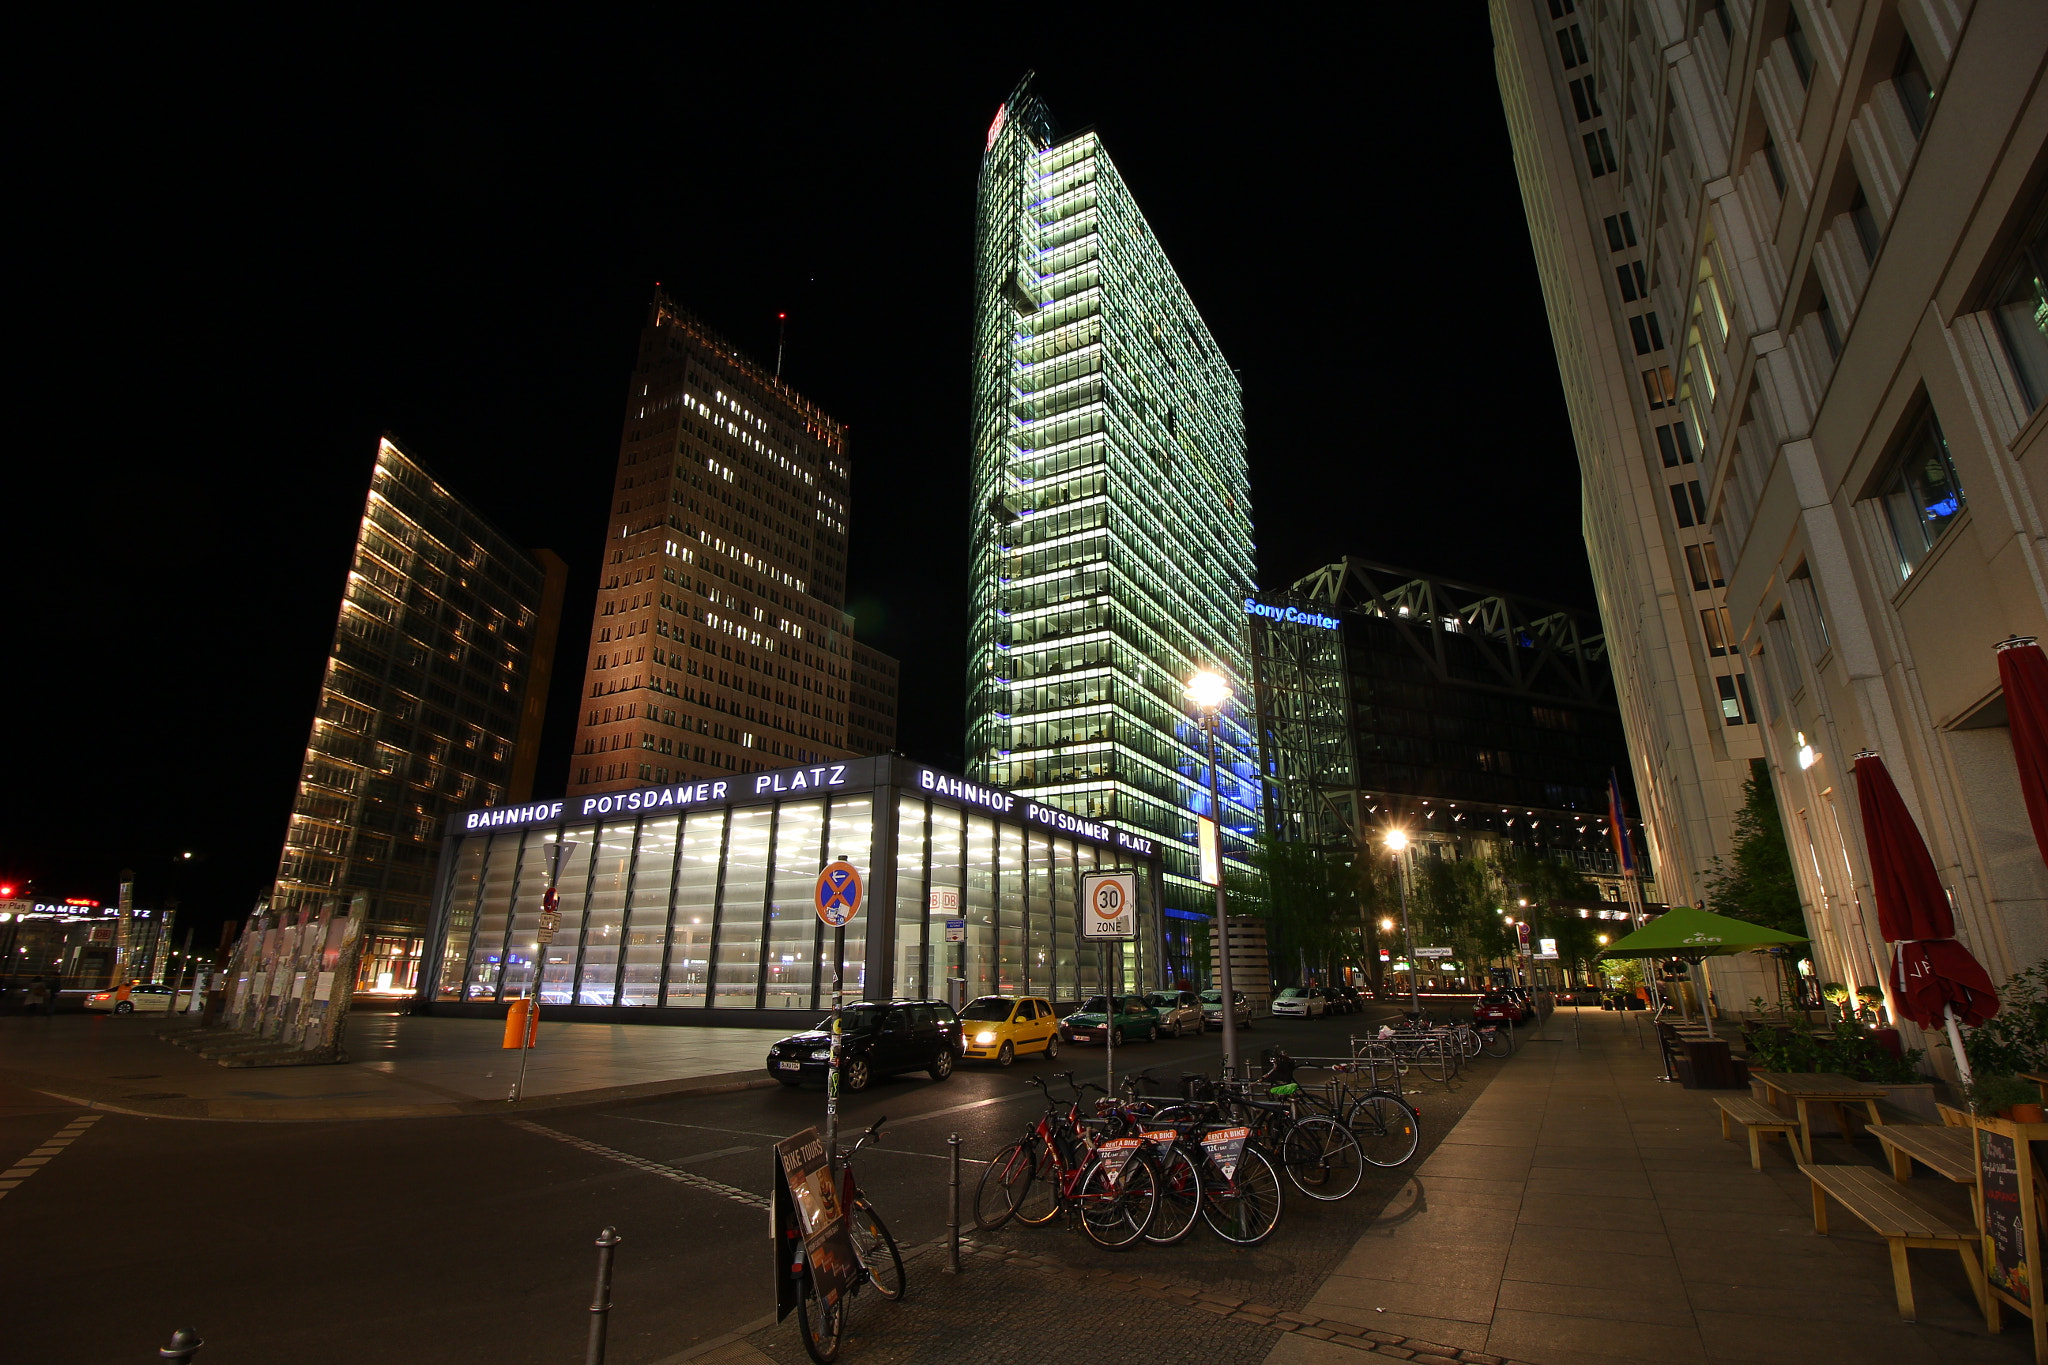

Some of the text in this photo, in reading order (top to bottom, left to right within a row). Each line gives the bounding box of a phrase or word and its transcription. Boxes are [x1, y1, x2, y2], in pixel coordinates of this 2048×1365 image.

[467, 766, 845, 828] BAHNHOF POTSDAMER PLATZ
[921, 769, 1152, 854] BAHNHOF POTSDAMER PLATZ
[944, 895, 956, 906] DB
[1100, 890, 1118, 908] 30
[34, 904, 151, 918] DAMER PLTZ
[1097, 922, 1121, 932] ZONE
[1229, 1129, 1245, 1137] BIKE
[783, 1138, 824, 1172] BIKE TOURS
